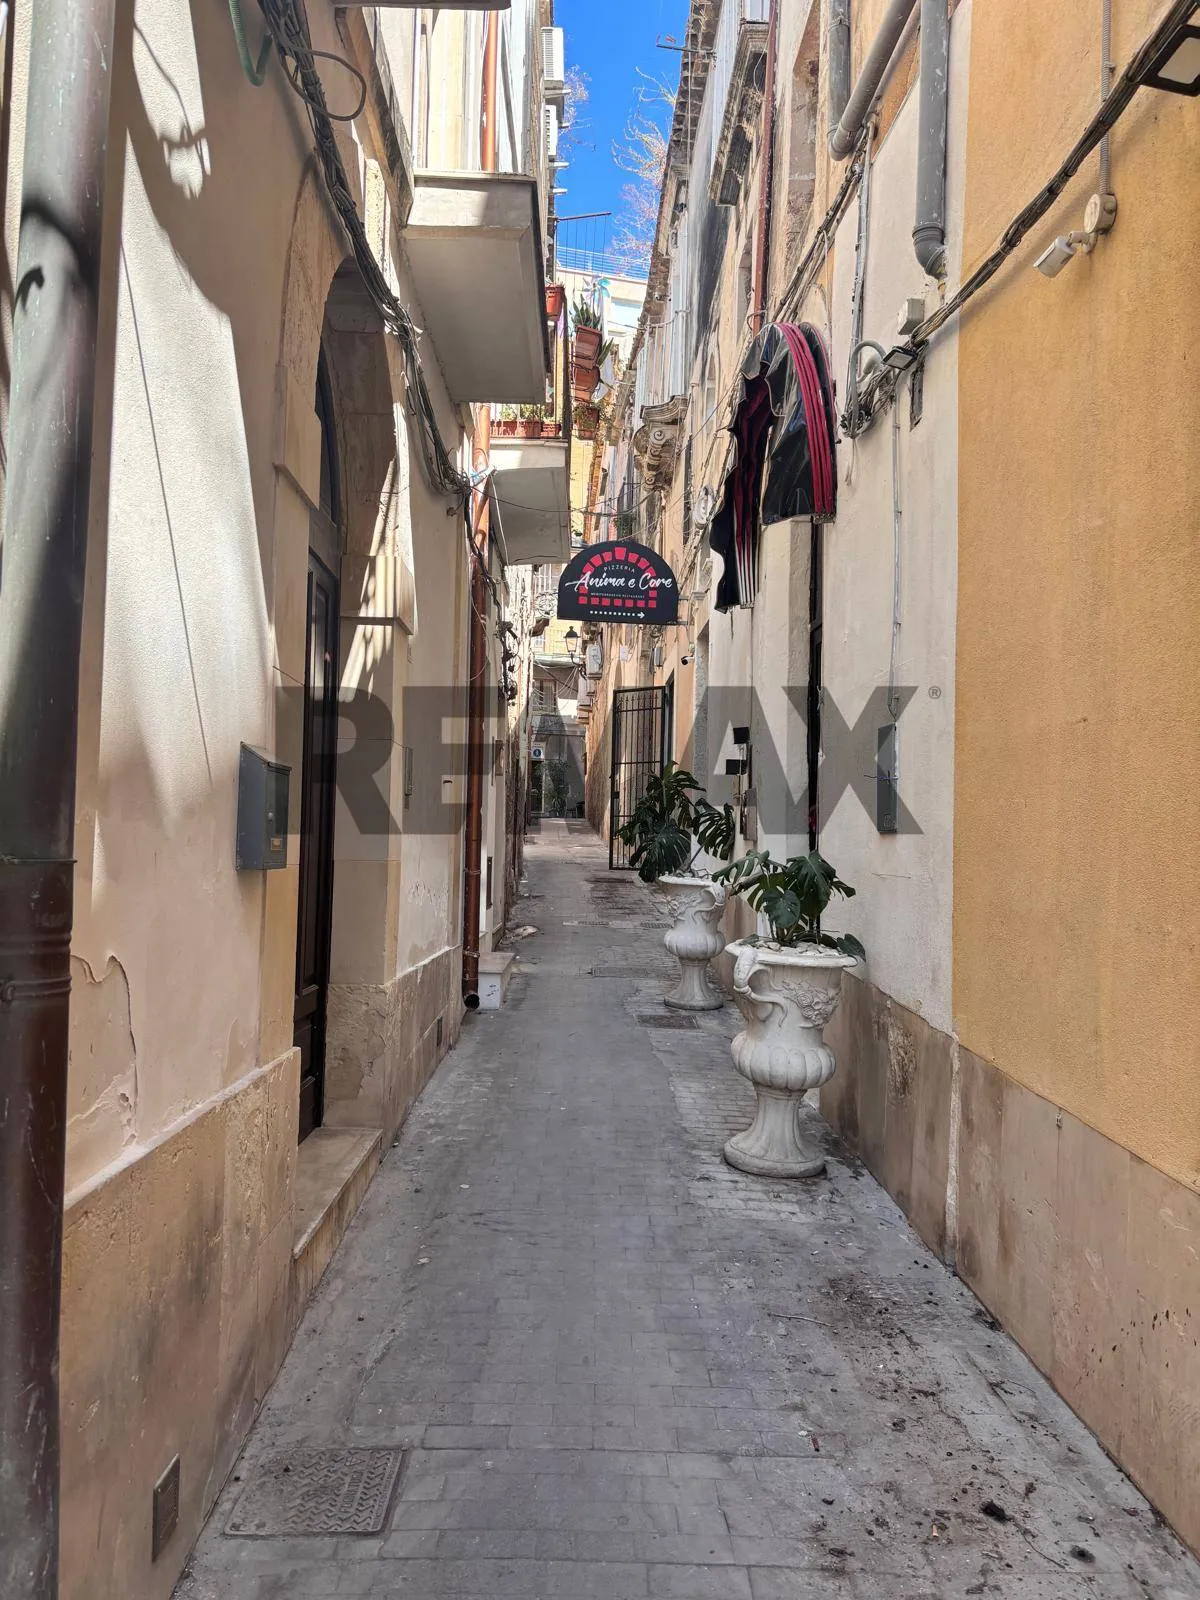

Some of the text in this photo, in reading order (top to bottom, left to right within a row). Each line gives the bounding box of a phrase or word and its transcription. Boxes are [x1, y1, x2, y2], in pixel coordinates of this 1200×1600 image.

[603, 564, 635, 573] PIZZERIA
[565, 570, 673, 592] Anima e Core
